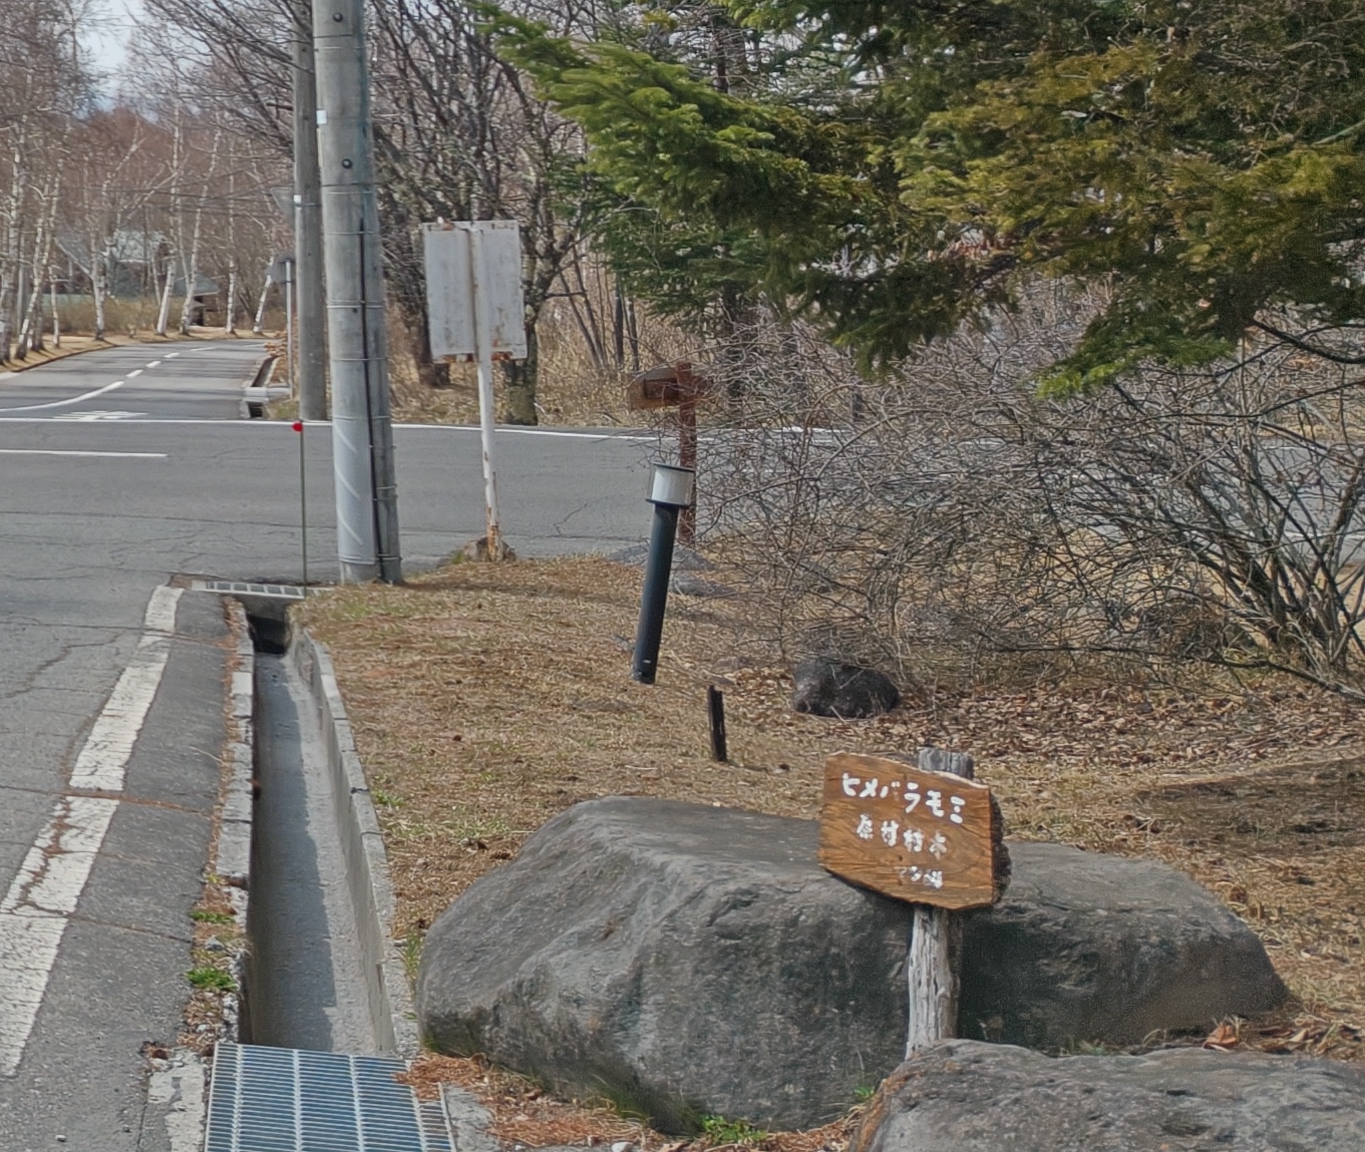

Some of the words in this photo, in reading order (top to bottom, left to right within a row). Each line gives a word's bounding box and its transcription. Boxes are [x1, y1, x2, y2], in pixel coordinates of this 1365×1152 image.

[842, 772, 966, 824] ヒメバラモミ
